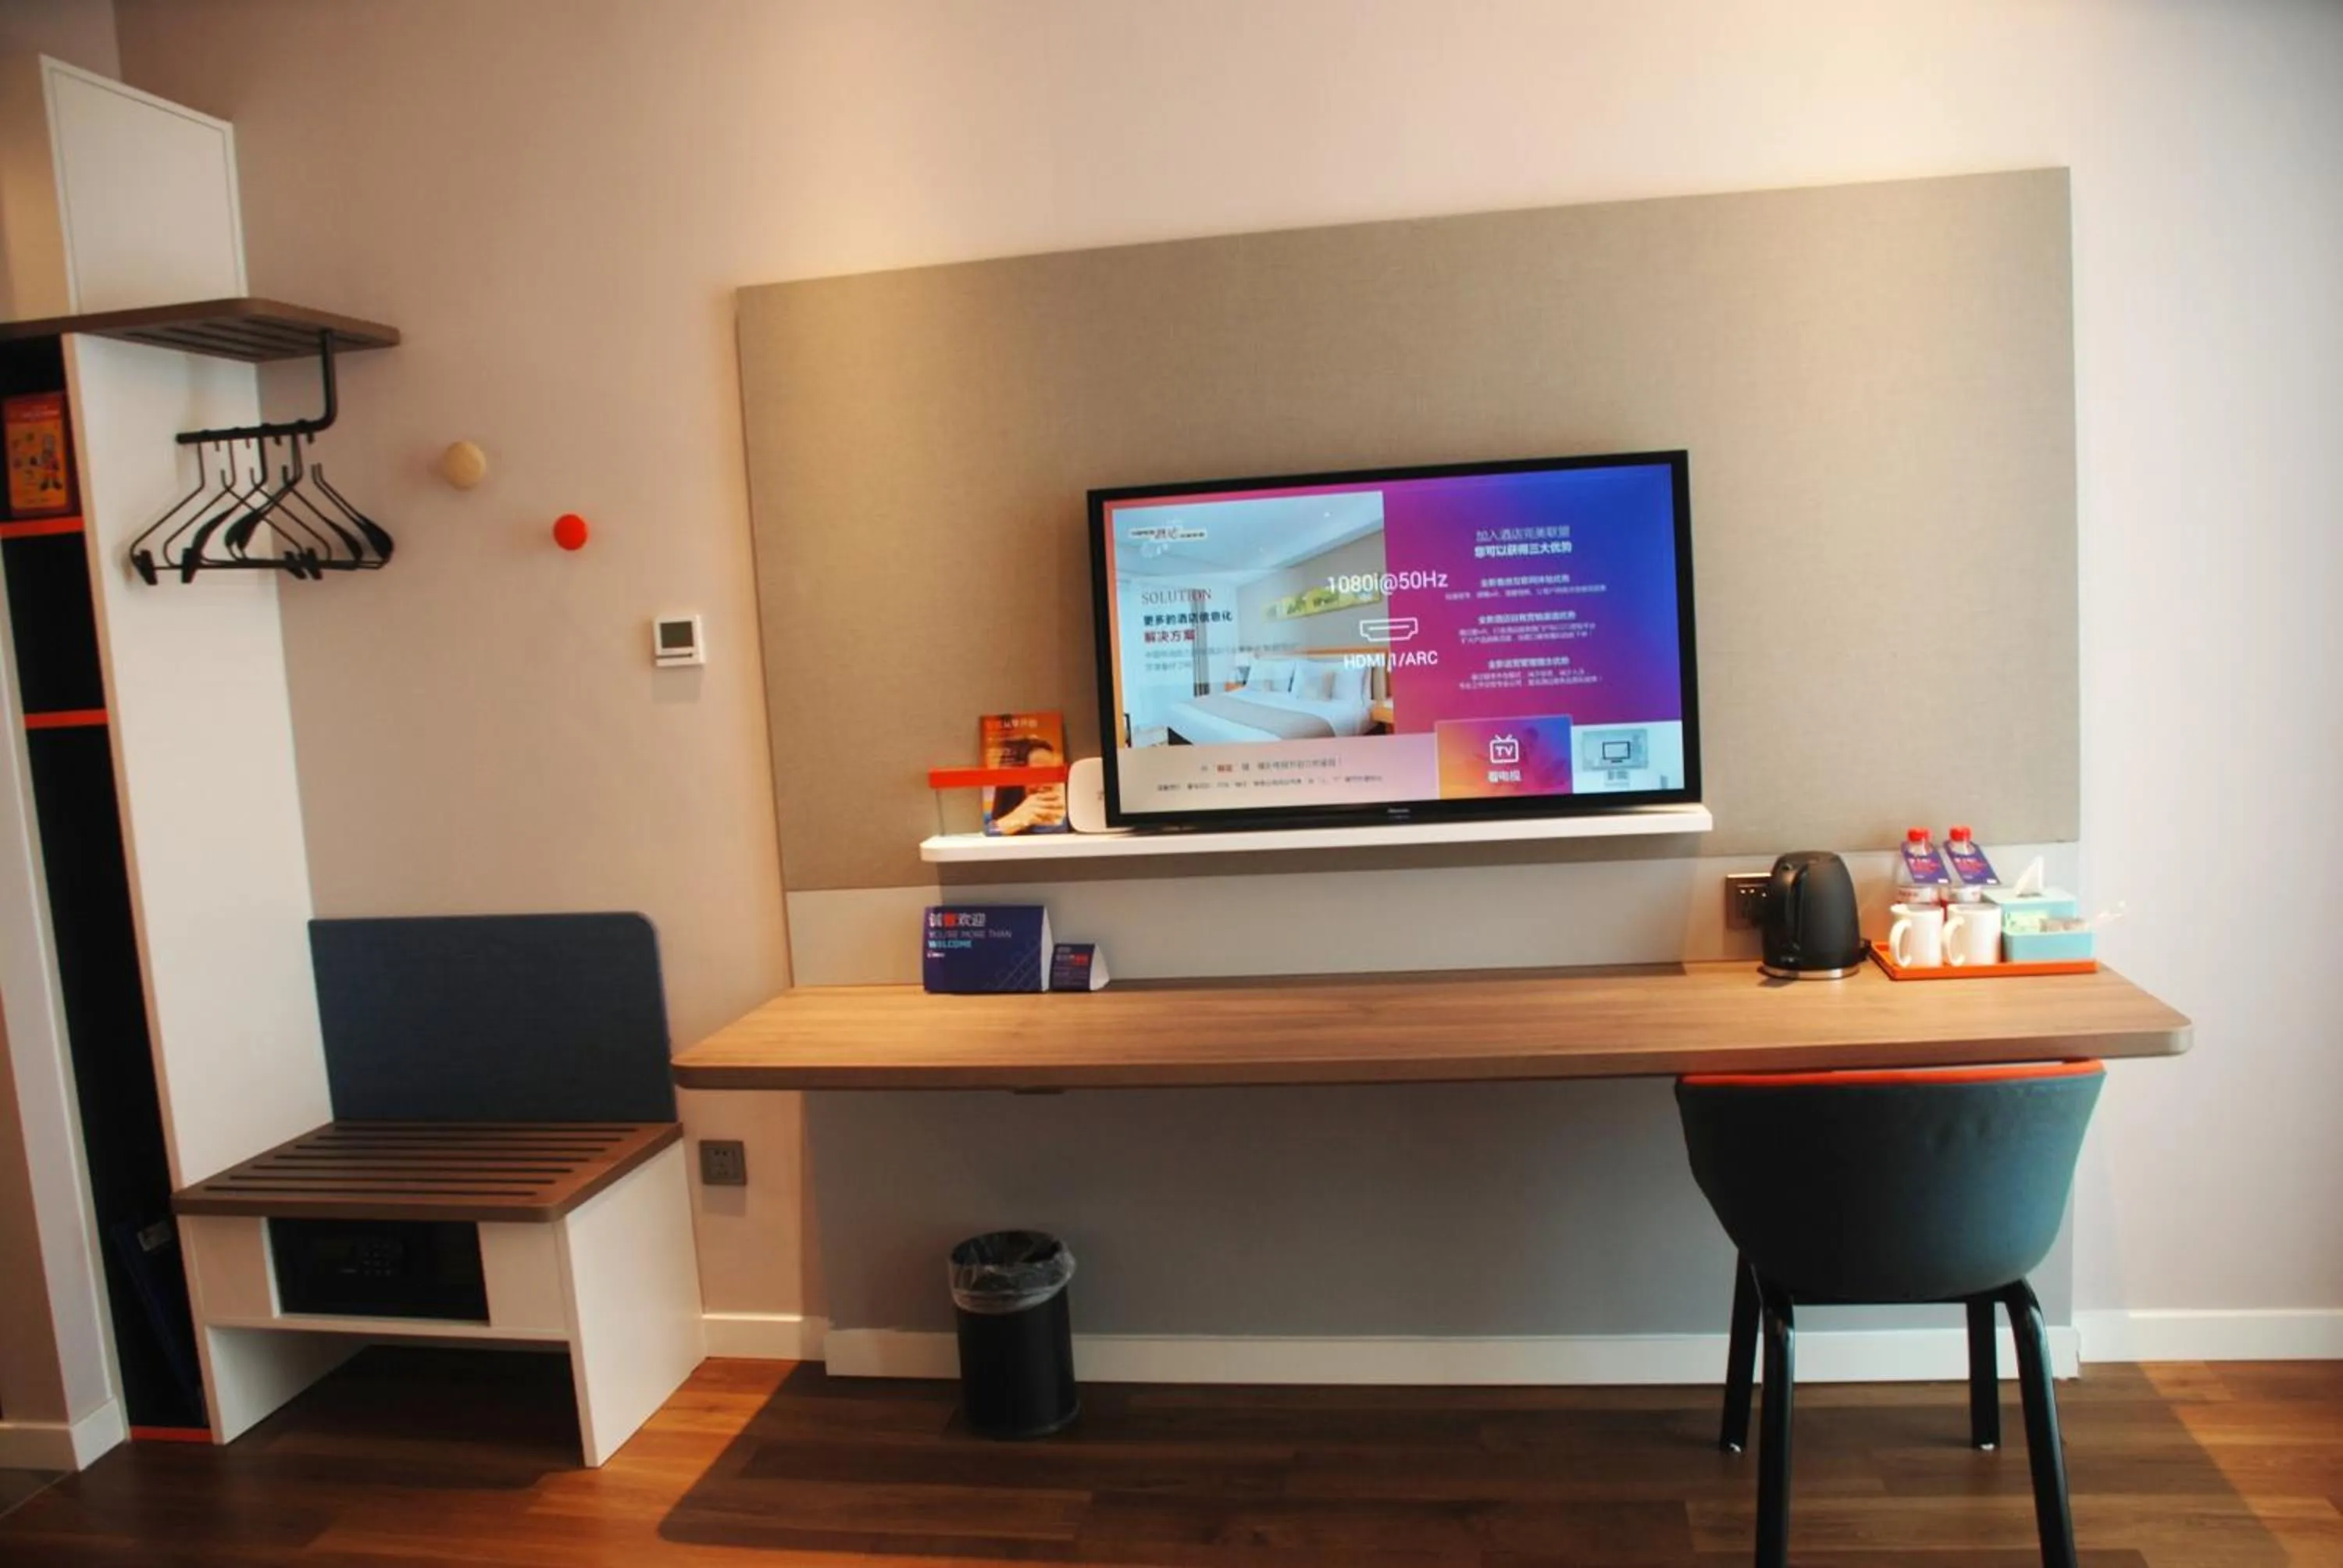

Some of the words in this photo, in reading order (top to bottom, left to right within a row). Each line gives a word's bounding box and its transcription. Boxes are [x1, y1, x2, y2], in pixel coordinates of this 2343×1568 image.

[1328, 570, 1449, 596] 1080i@50Hz
[1141, 588, 1212, 605] SOLUTION
[1144, 629, 1196, 643] 解决方案
[1343, 653, 1385, 669] HDMI
[1495, 745, 1514, 757] TV
